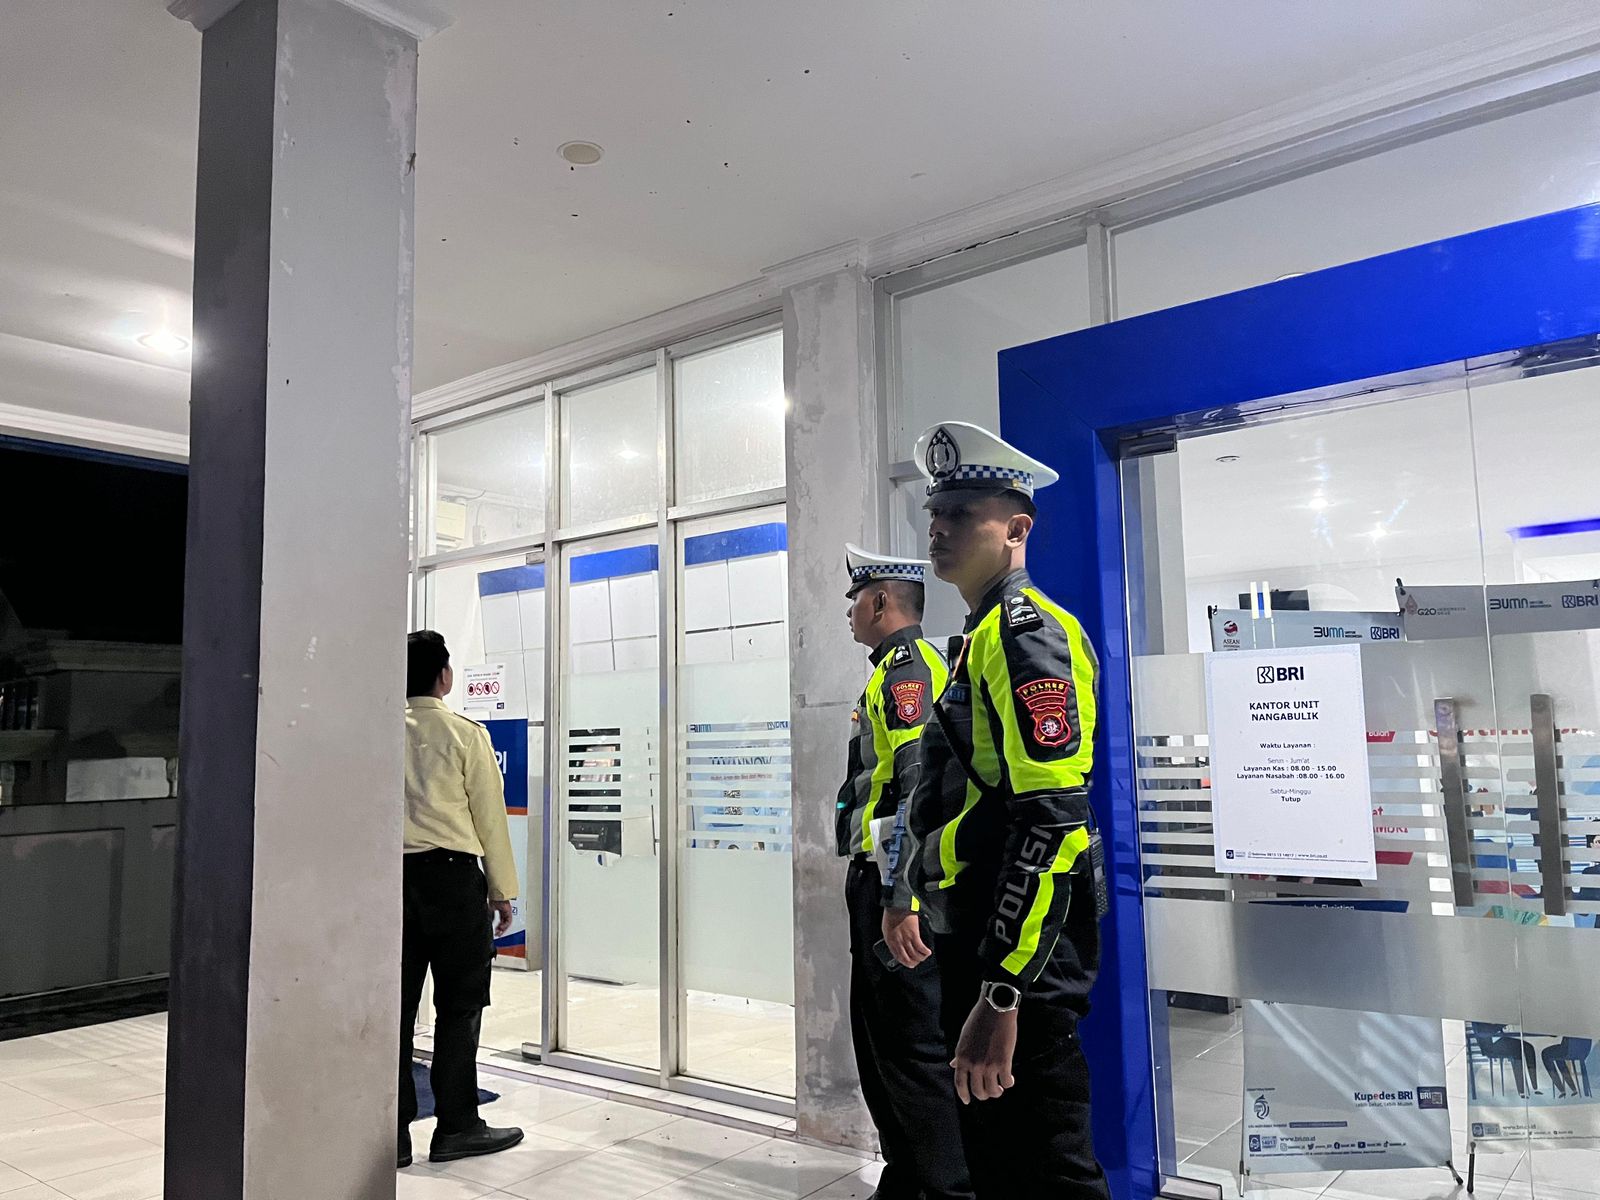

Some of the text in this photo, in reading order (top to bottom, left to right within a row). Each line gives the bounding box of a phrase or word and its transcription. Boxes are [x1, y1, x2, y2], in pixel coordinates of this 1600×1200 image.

[1576, 594, 1600, 607] BRI
[1417, 608, 1437, 616] G20
[1383, 627, 1400, 639] BRI
[1276, 666, 1305, 681] BRI
[1022, 682, 1065, 696] POLRES
[1249, 700, 1320, 710] KANTOR UNIT
[1251, 712, 1319, 721] NANGABULIK
[994, 826, 1053, 945] POLISI
[1354, 1090, 1413, 1102] Kupedes BRI
